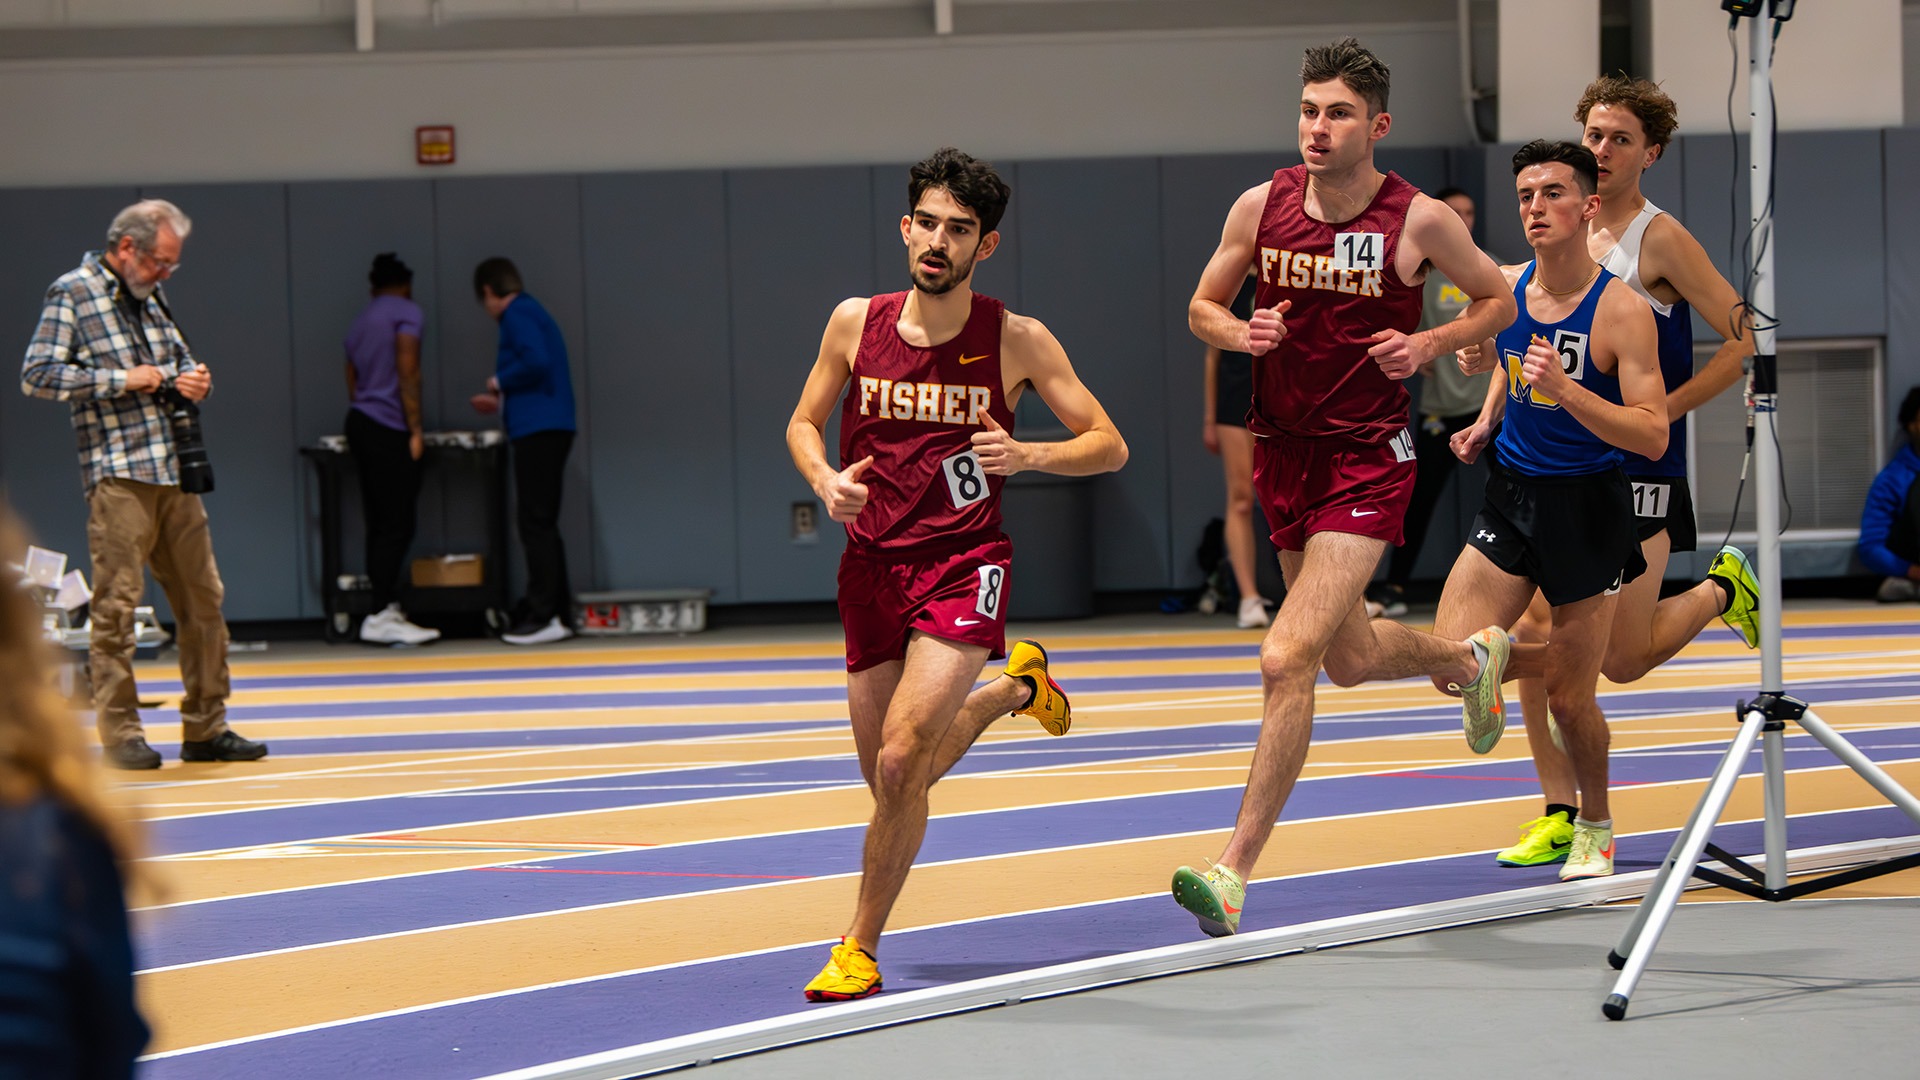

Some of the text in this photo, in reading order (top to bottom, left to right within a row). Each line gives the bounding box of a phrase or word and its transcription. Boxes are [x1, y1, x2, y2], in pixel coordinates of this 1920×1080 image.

[1261, 246, 1383, 297] FISHER
[1343, 235, 1375, 268] 14
[1557, 333, 1581, 375] 5
[859, 376, 991, 425] FISHER
[953, 456, 982, 501] 8
[1634, 485, 1660, 516] 11
[984, 568, 1001, 614] 8
